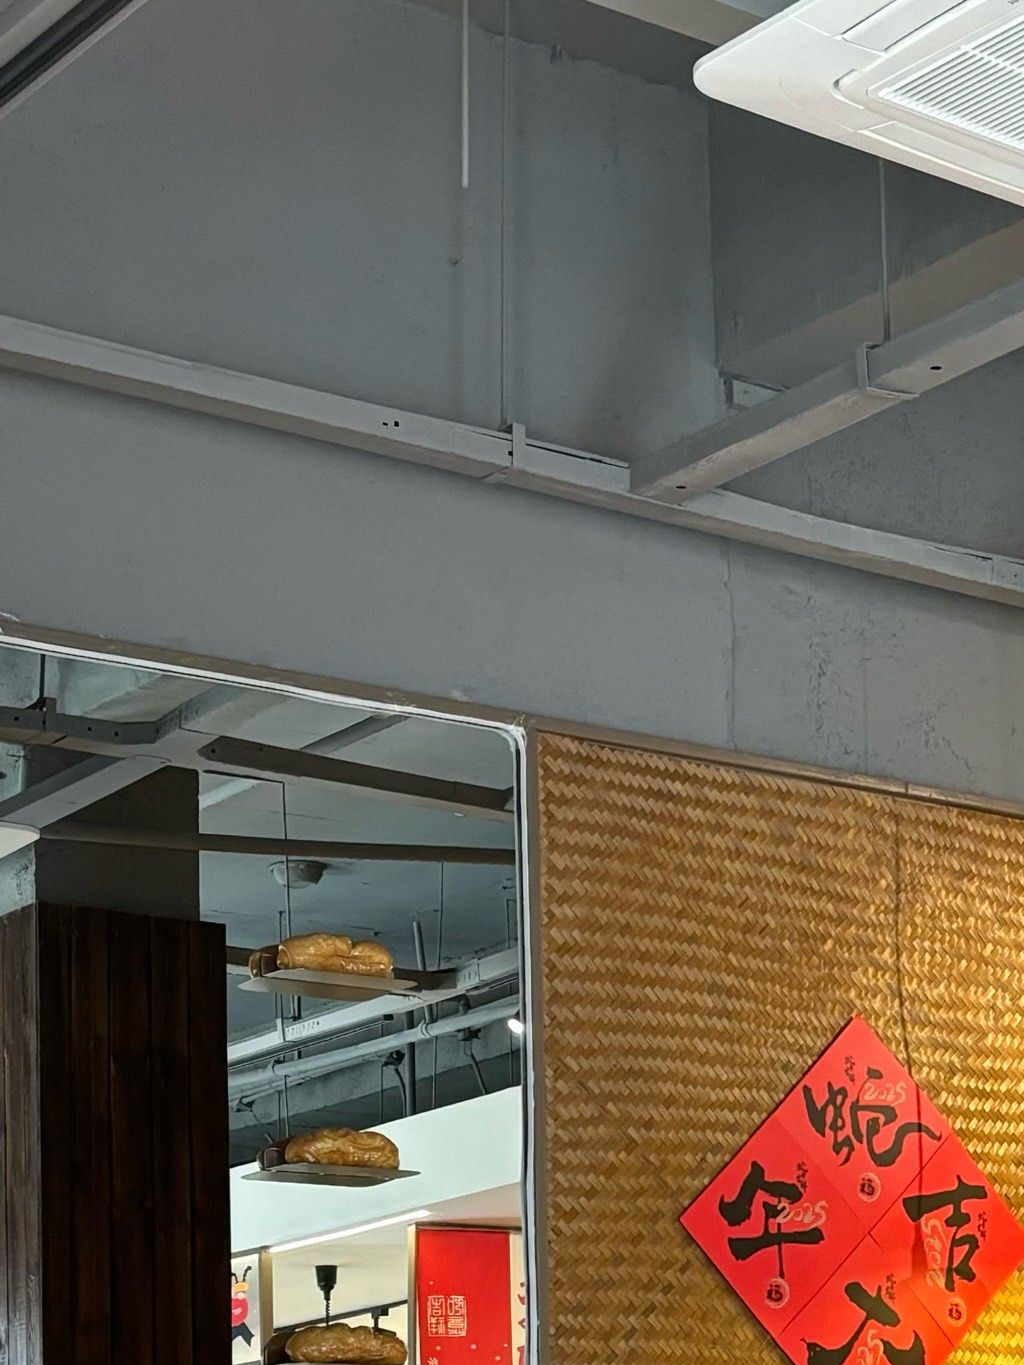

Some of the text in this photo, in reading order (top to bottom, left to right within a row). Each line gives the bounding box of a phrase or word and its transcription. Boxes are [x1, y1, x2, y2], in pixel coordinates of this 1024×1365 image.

[718, 1160, 825, 1279] 年
[776, 1200, 828, 1230] 2025
[902, 1174, 988, 1292] 吉
